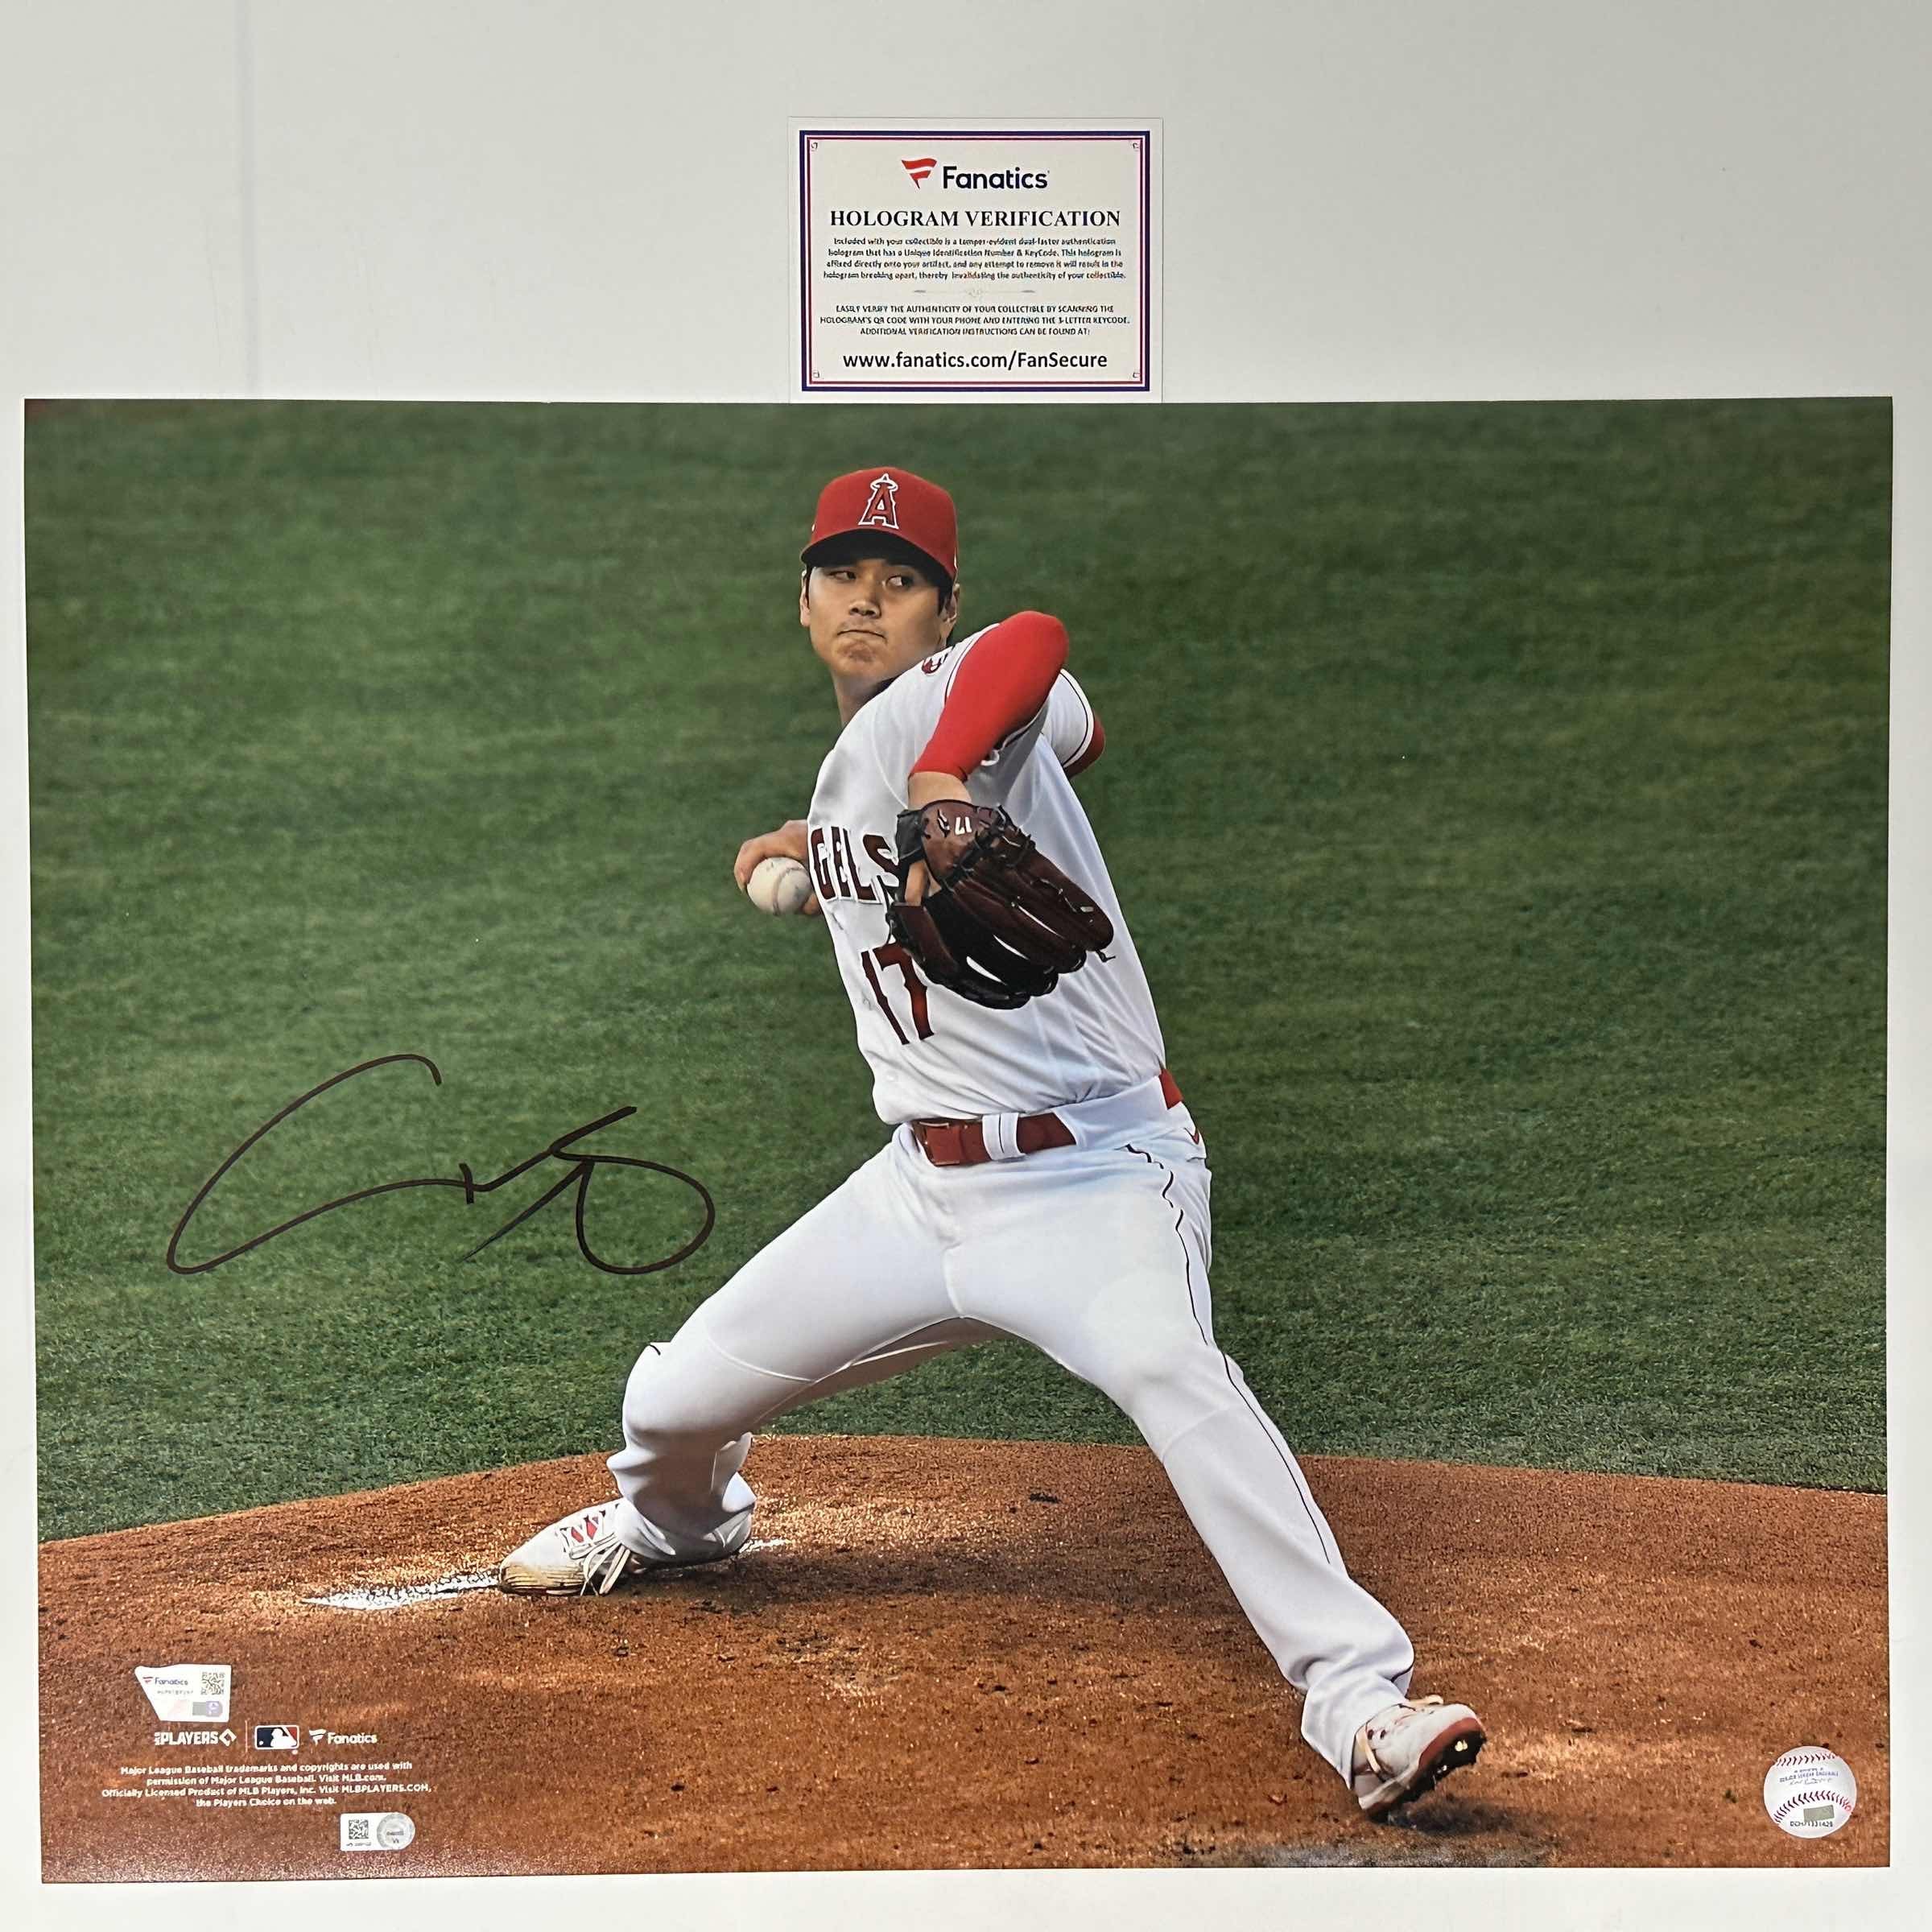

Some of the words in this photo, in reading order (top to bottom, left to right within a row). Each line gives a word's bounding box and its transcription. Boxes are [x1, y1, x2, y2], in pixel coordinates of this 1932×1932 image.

[943, 166, 1048, 189] Fanatics
[831, 211, 958, 226] HOLOGRAM
[964, 211, 1120, 226] VERIFICATION
[833, 237, 866, 246] Included
[867, 237, 885, 246] with
[886, 239, 903, 247] your
[905, 237, 943, 246] collectible
[1061, 237, 1117, 246] authentication
[828, 248, 865, 258] hologram
[865, 248, 881, 257] that
[882, 248, 896, 257] has
[904, 248, 931, 258] Unique
[932, 248, 983, 257] Identification
[984, 248, 1015, 257] Number
[1025, 248, 1060, 258] KeyCode.
[1061, 248, 1076, 257] This
[1077, 248, 1114, 258] hologram
[853, 259, 882, 269] directly
[902, 262, 920, 270] your
[922, 259, 952, 269] artifact,
[952, 260, 968, 268] and
[968, 261, 983, 270] any
[984, 260, 1015, 270] attempt
[1016, 260, 1025, 268] to
[1063, 259, 1077, 268] will
[1078, 259, 1100, 268] result
[1110, 260, 1124, 268] the
[823, 270, 860, 280] hologram
[861, 270, 894, 281] breaking
[894, 271, 918, 281] apart,
[919, 270, 948, 281] thereby
[952, 270, 996, 281] invalidating
[997, 271, 1009, 279] the
[1011, 271, 1056, 281] authenticity
[1057, 270, 1067, 279] of
[1067, 273, 1085, 281] your
[1086, 270, 1127, 279] collectible.
[890, 305, 904, 313] THE
[906, 305, 961, 313] AUTHENTICITY
[962, 305, 972, 313] OF
[974, 305, 997, 313] YOUR
[997, 305, 1045, 314] COLLECTIBLE
[1046, 305, 1057, 313] BY
[1100, 305, 1114, 313] THE
[873, 316, 886, 324] QR
[886, 316, 907, 324] CODE
[908, 316, 930, 324] WITH
[931, 316, 953, 324] YOUR
[954, 316, 981, 324] PHONE
[983, 316, 1001, 324] AND
[1042, 316, 1056, 324] THE
[860, 328, 907, 336] ADDITIONAL
[962, 328, 1018, 336] INSTRUCTIONS
[1019, 328, 1036, 336] CAN
[1037, 327, 1047, 336] BE
[1048, 328, 1076, 336] FOUND
[843, 350, 1107, 370] www.fanatics.com/FanSecure
[858, 472, 899, 529] A
[861, 943, 935, 1046] 17
[160, 1731, 219, 1745] PLAYERS
[328, 1732, 378, 1744] Fanatics
[121, 1766, 147, 1776] Major
[149, 1765, 182, 1776] League
[184, 1765, 223, 1773] Baseball
[225, 1763, 278, 1773] trademarks
[280, 1763, 297, 1772] and
[299, 1762, 349, 1773] copyrights
[368, 1762, 390, 1770] used
[392, 1761, 412, 1769] with
[147, 1777, 196, 1786] permission
[199, 1776, 209, 1785] of
[210, 1776, 237, 1785] Major
[239, 1776, 272, 1785] League
[319, 1773, 340, 1782] Visit
[101, 1789, 142, 1798] Officially
[145, 1788, 186, 1797] Licensed
[188, 1787, 225, 1796] Product
[226, 1787, 237, 1795] of
[238, 1787, 259, 1795] MLB
[319, 1785, 340, 1794] Visit
[196, 1798, 212, 1806] the
[213, 1798, 247, 1808] Players
[250, 1798, 281, 1806] Choice
